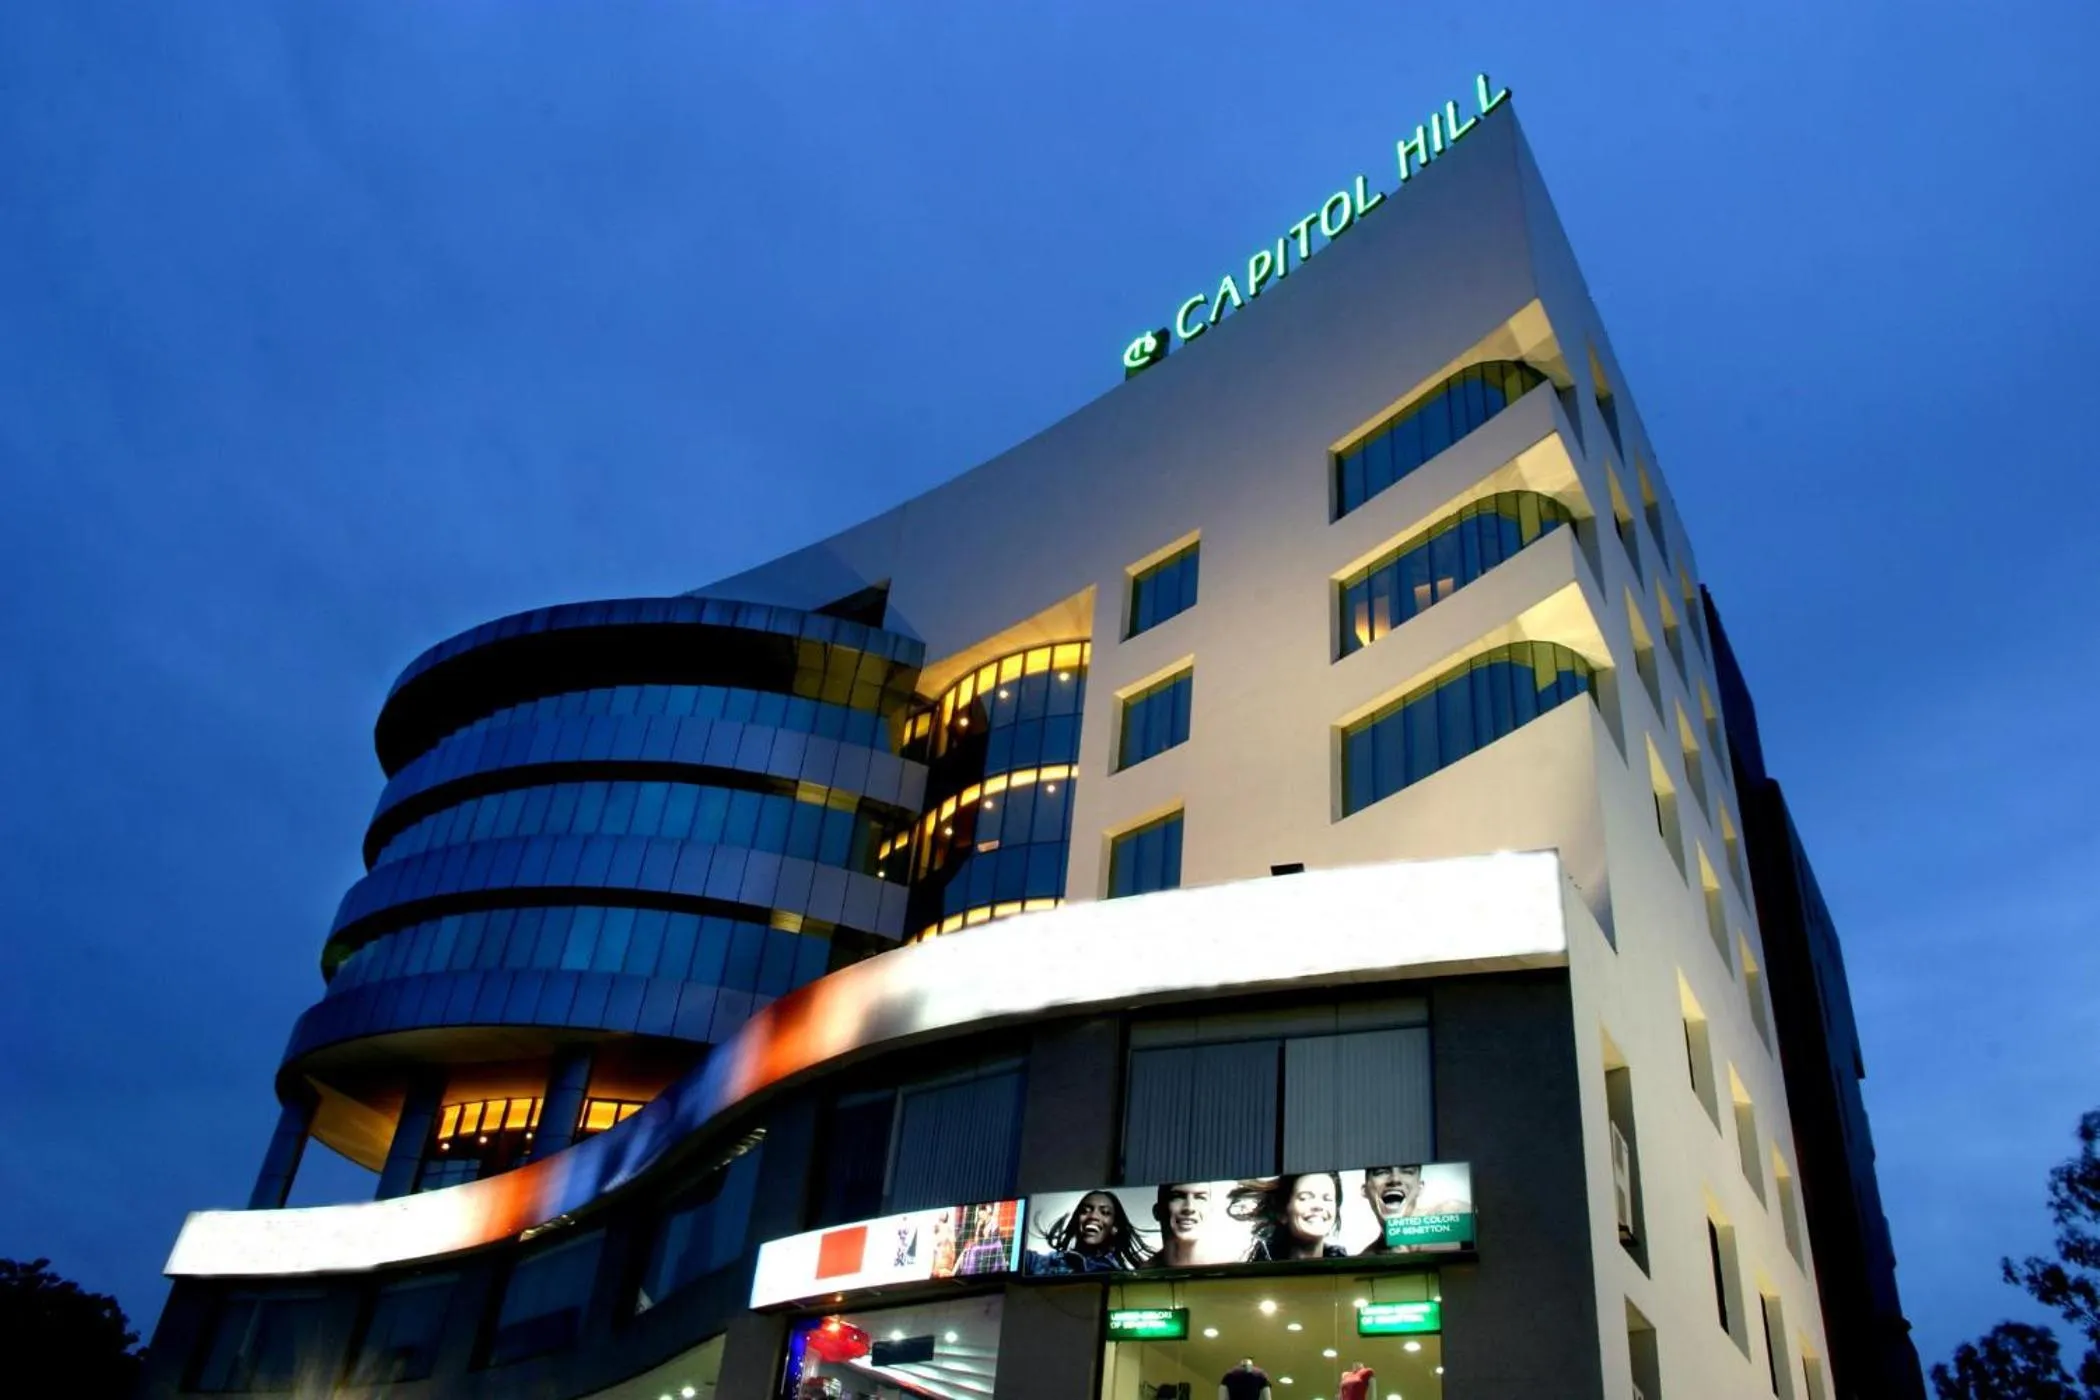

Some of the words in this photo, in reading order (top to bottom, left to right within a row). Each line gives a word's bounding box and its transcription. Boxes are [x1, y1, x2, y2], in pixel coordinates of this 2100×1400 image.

[1176, 175, 1384, 341] CAPITOL
[1397, 73, 1510, 181] HILL
[1388, 1217, 1421, 1227] UNITED
[1423, 1214, 1460, 1225] COLORS
[1388, 1226, 1401, 1236] OF
